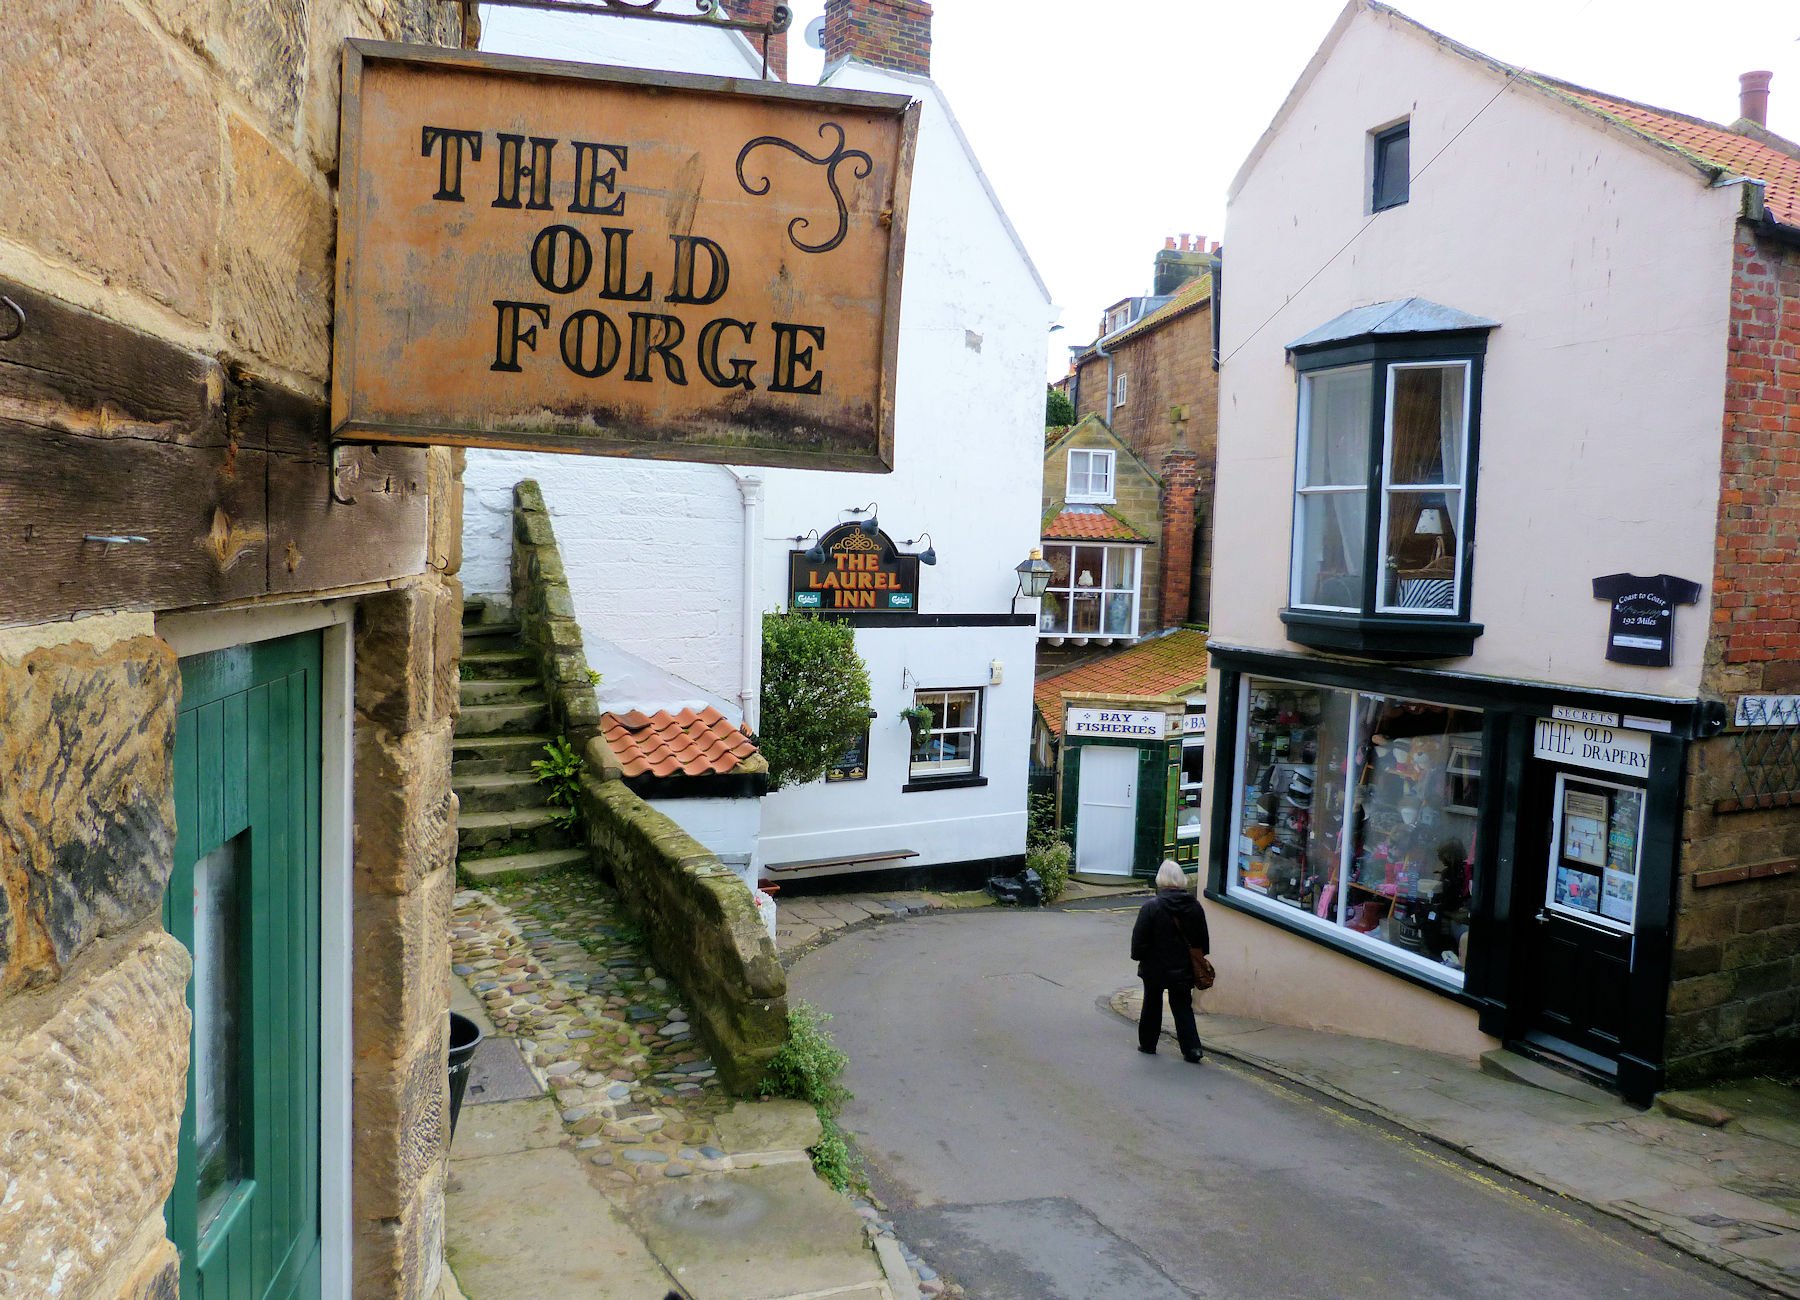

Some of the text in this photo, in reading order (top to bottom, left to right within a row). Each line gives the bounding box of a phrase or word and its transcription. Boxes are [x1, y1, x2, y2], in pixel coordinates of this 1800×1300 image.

[421, 125, 629, 217] THE
[530, 224, 731, 306] OLD
[489, 299, 826, 395] FORGE
[833, 552, 880, 572] THE
[808, 570, 902, 590] LAUREL
[834, 590, 877, 608] INN
[1622, 616, 1657, 626] 192 Miles
[1099, 712, 1133, 722] BAY
[1557, 708, 1613, 724] SECRETS
[1076, 722, 1156, 735] FISHERIES
[1538, 718, 1613, 755] THE OLD
[1582, 743, 1650, 768] DRAPERY
